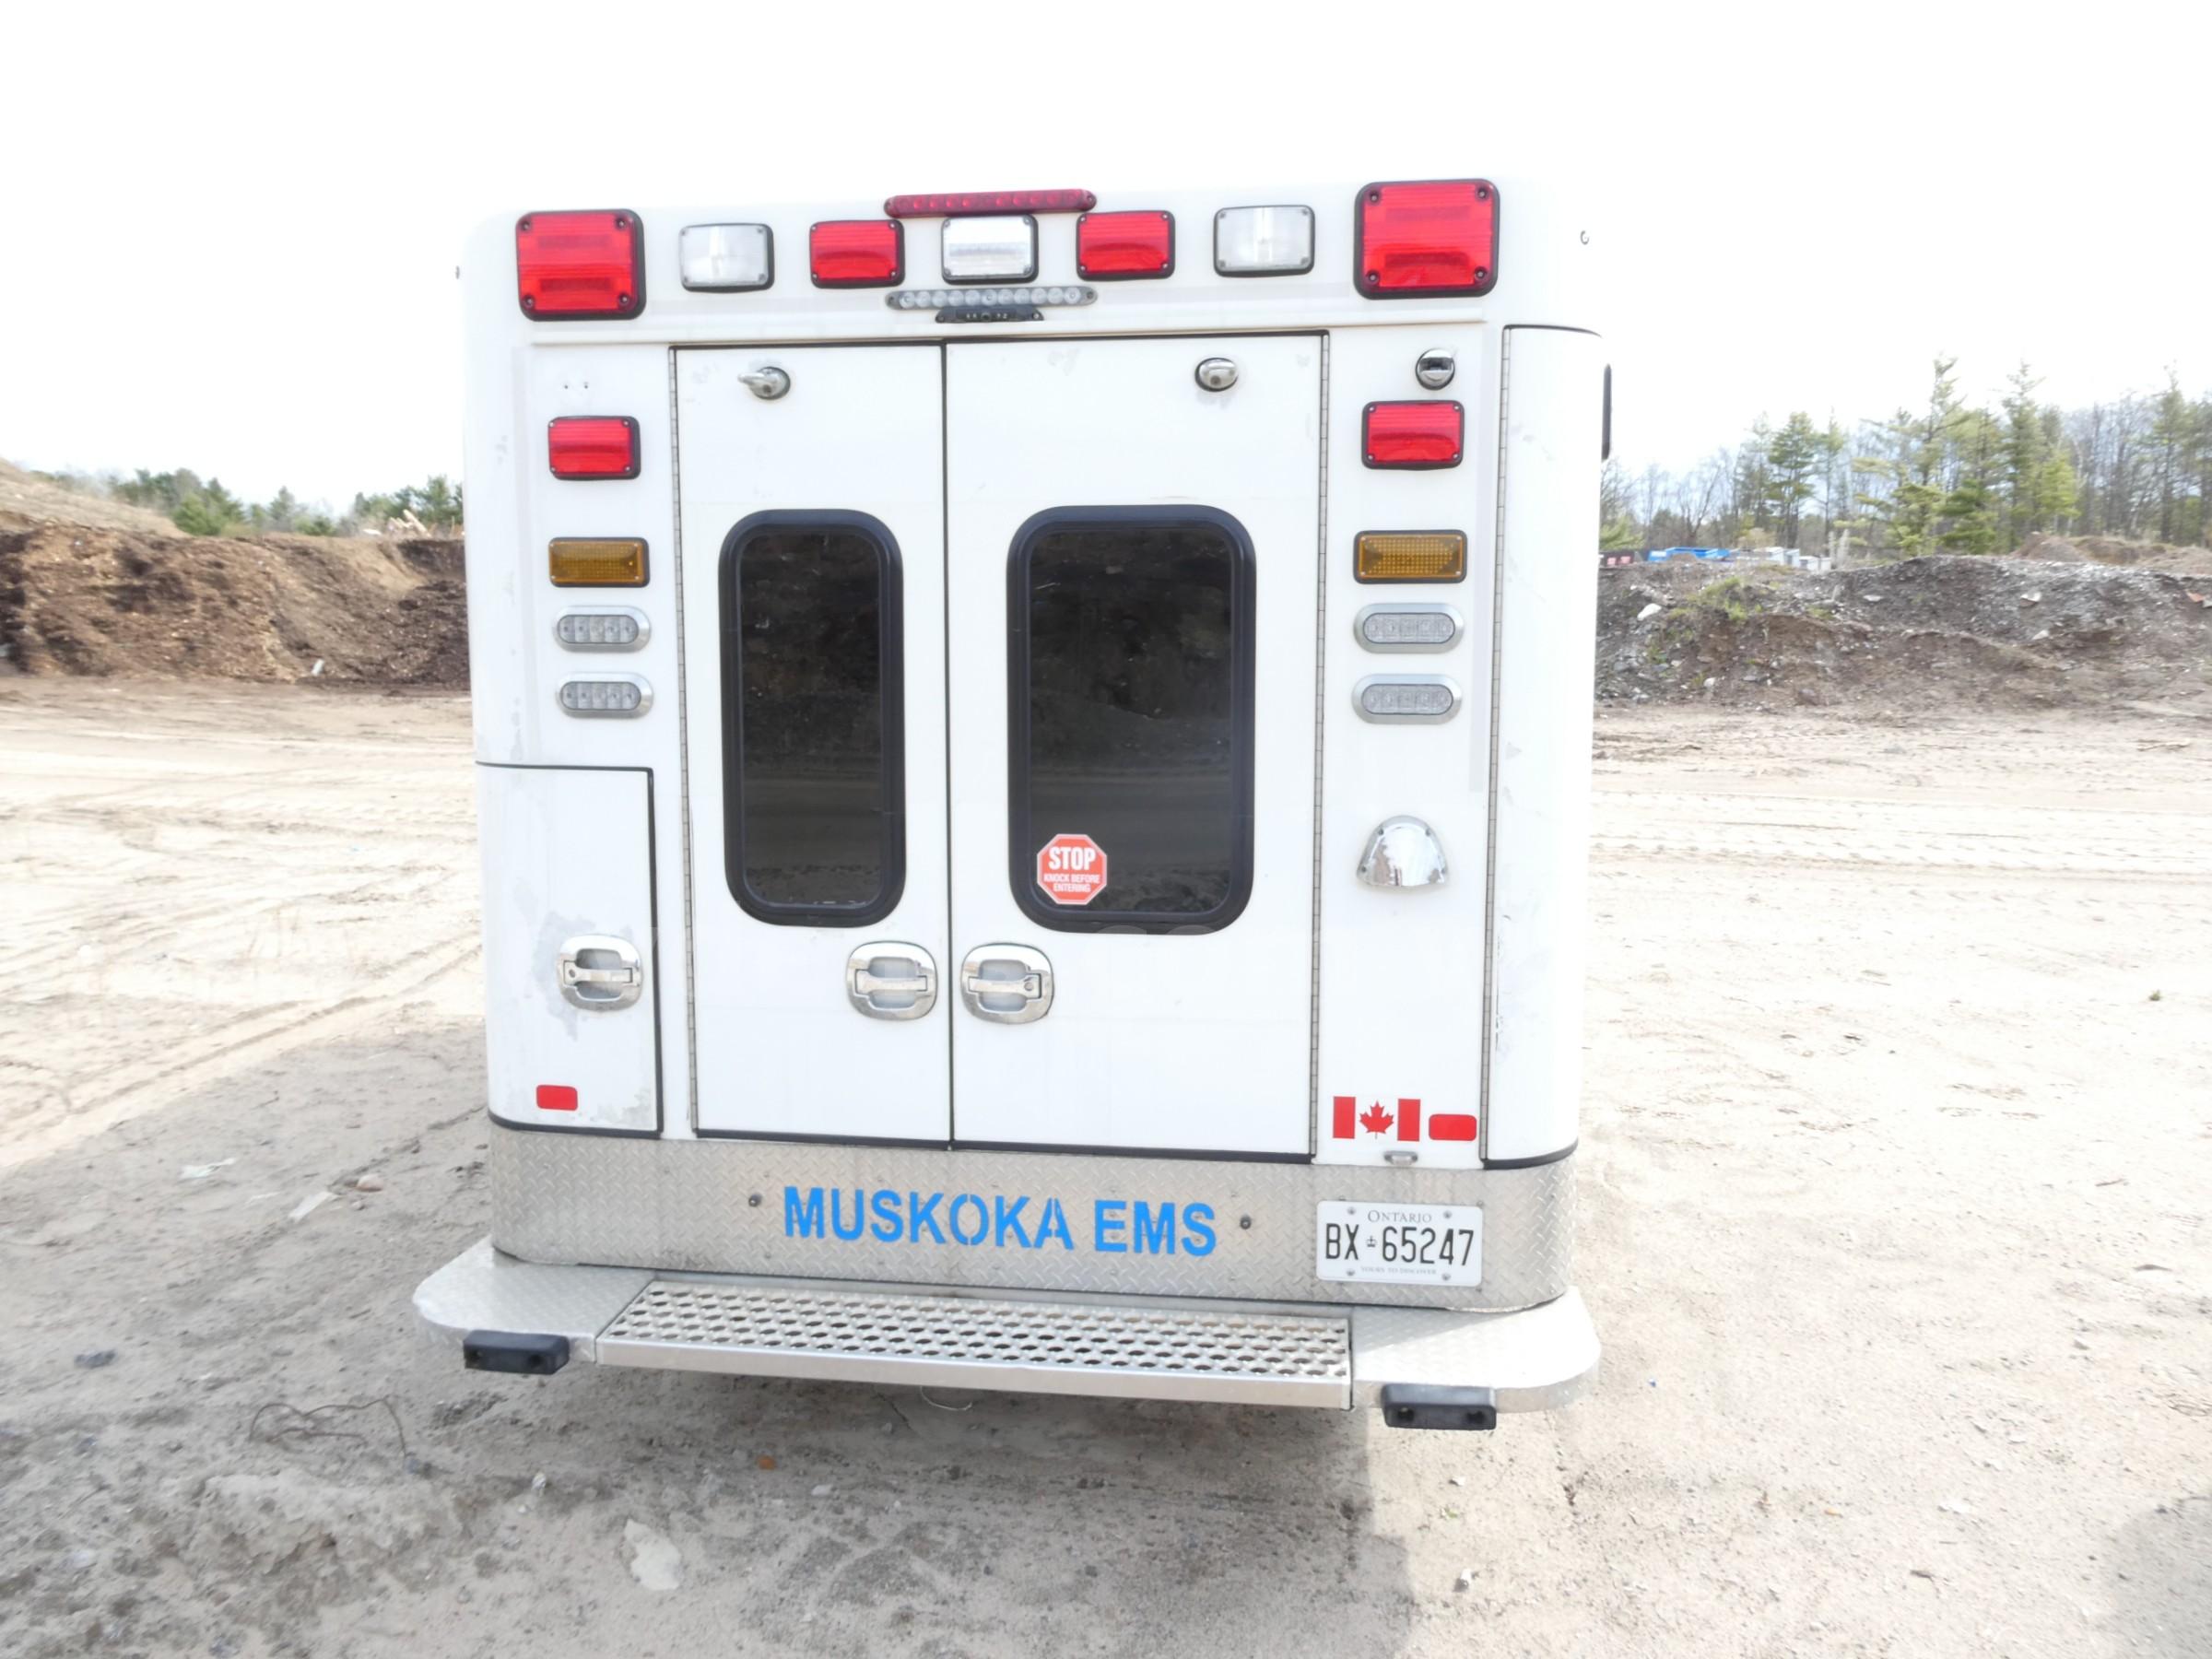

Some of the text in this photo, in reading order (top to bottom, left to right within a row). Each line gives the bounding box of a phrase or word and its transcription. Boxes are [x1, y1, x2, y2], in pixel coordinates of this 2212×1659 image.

[1048, 846, 1097, 871] STOP
[1043, 873, 1101, 885] KNOCK BEFORE
[1053, 883, 1091, 893] ENTERING
[784, 1186, 1217, 1256] MUSKOKA EMS
[1324, 1223, 1475, 1266] BX 65247
